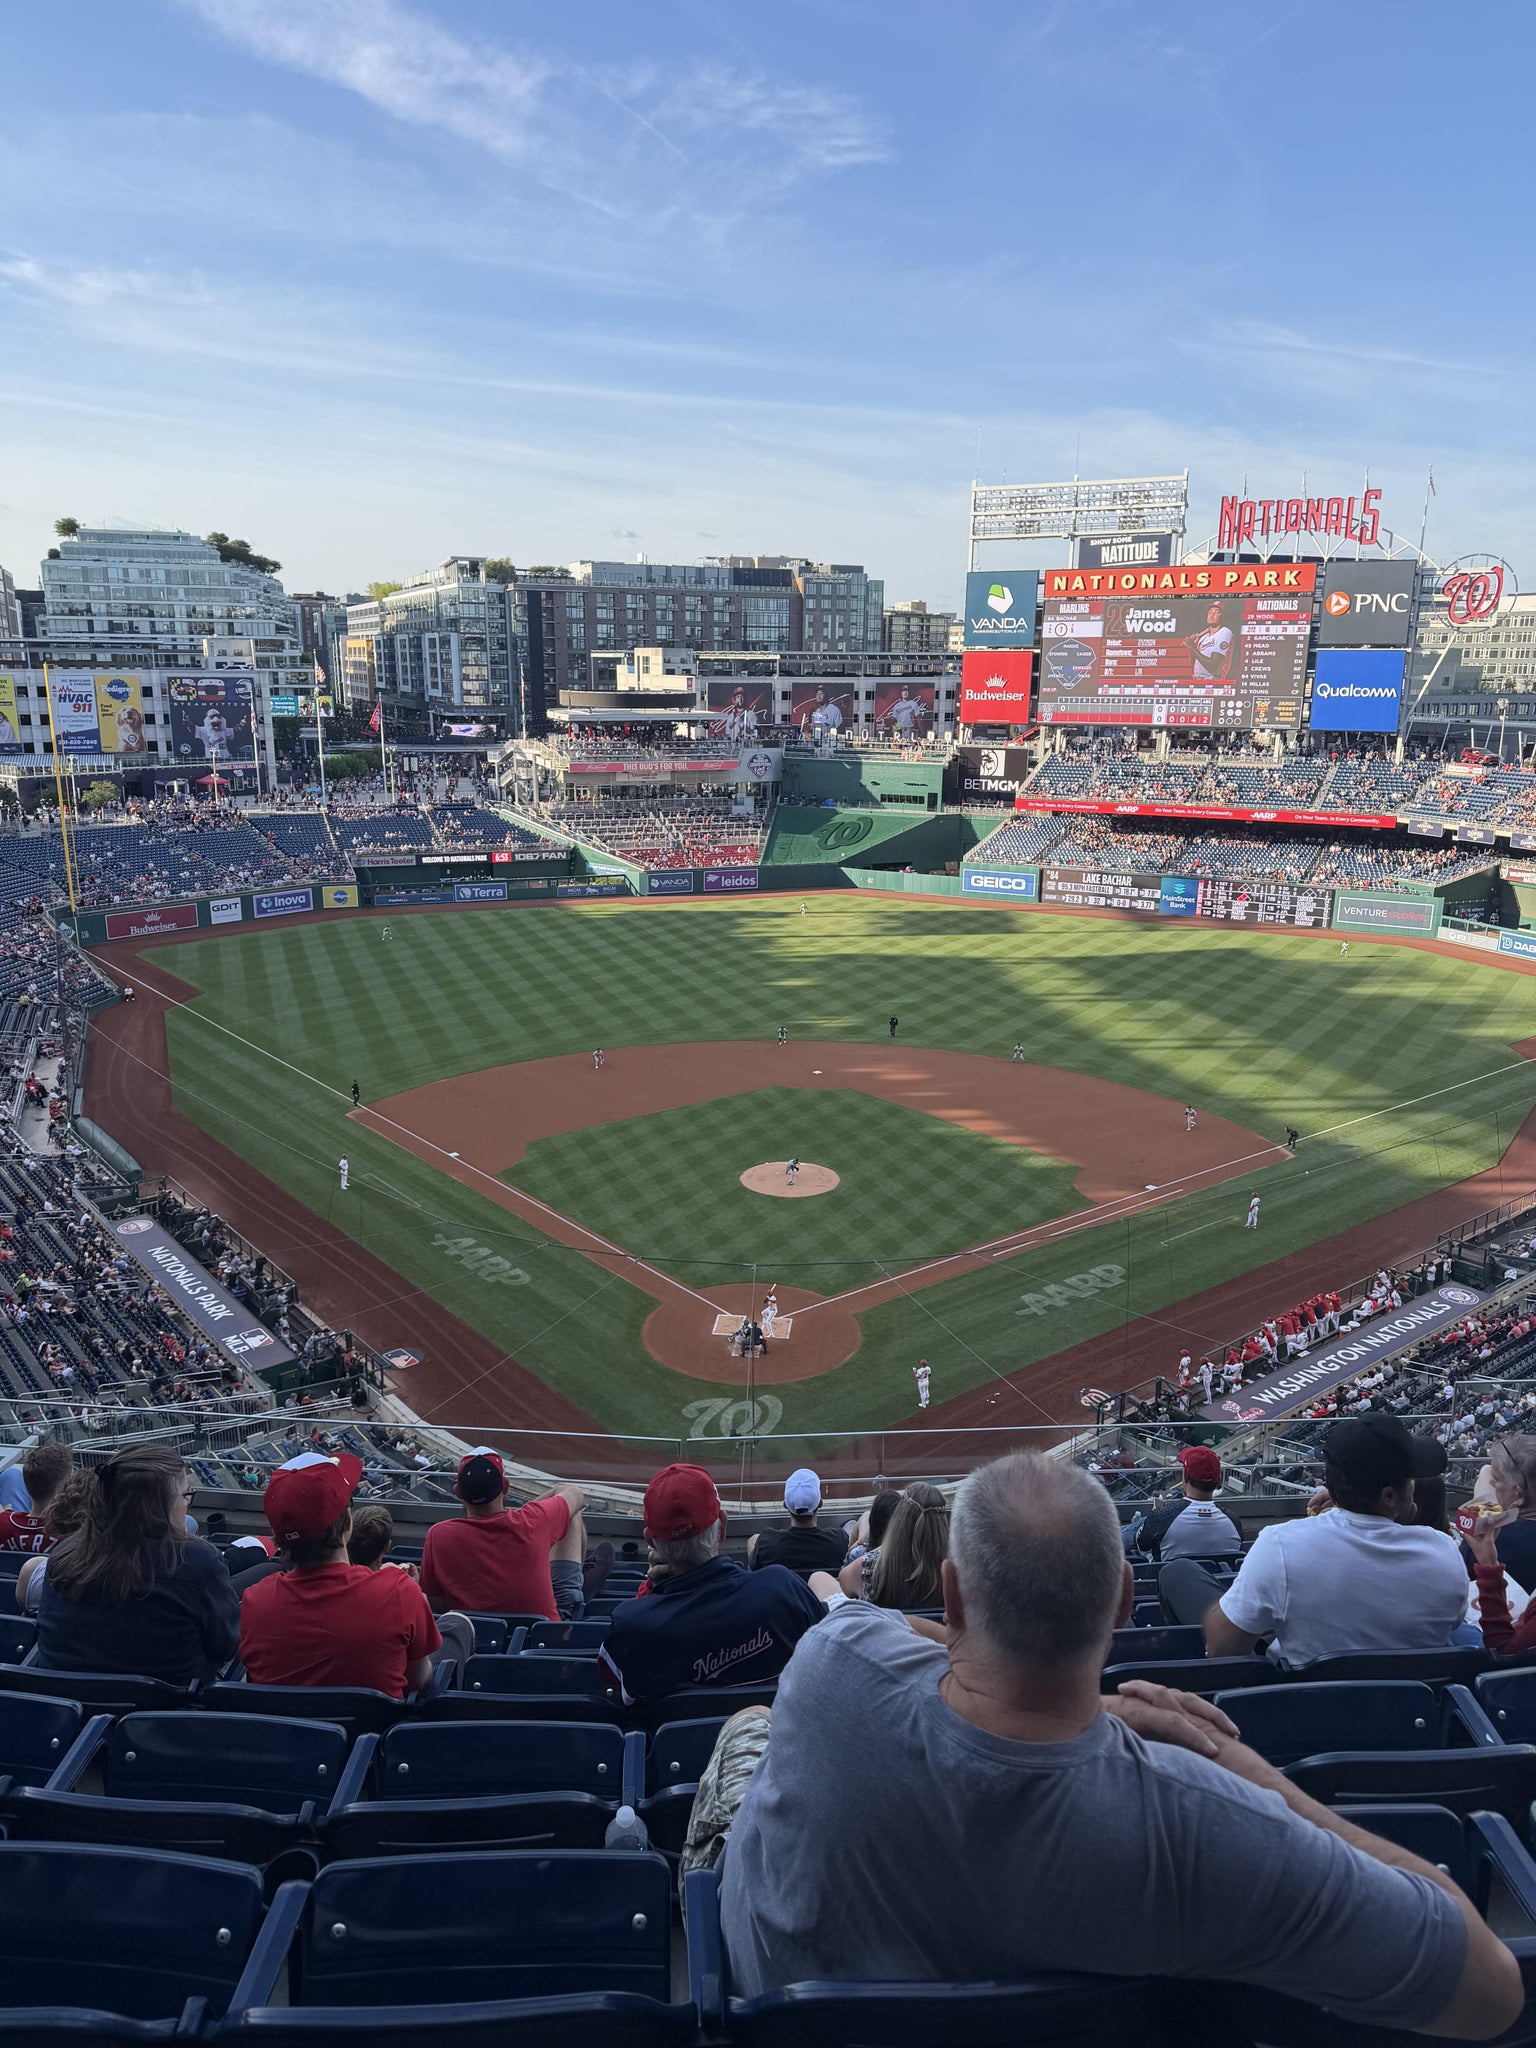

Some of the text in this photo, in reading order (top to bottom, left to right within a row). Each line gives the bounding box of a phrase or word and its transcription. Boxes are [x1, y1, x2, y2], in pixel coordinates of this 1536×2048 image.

[1218, 489, 1382, 549] NATIONALS
[1090, 536, 1132, 546] SHOW SOME
[1101, 541, 1159, 563] NATITUDE
[1054, 570, 1302, 590] NATIONALS PARK
[1443, 566, 1503, 624] W
[1060, 603, 1089, 613] MARLINS
[1257, 600, 1298, 611] NATIONALS
[1354, 593, 1409, 613] PNC
[1125, 608, 1171, 619] James
[971, 617, 1028, 629] VANDA
[1125, 618, 1176, 633] Wood
[100, 685, 135, 693] Pedigree
[965, 689, 1025, 701] Budweiser
[1317, 683, 1397, 698] Qualcomm
[58, 694, 93, 703] HVAC
[72, 703, 92, 713] 911
[964, 777, 1019, 792] BETMGM
[388, 857, 414, 865] Teeter
[495, 853, 508, 862] 6:53
[542, 852, 566, 860] FAN
[721, 874, 756, 887] leidos
[1046, 870, 1059, 880] #84
[1082, 873, 1132, 887] LAKE BACHAR
[970, 874, 1026, 890] GEICO
[472, 887, 503, 897] Terra
[1086, 885, 1110, 893] FASTBALL
[274, 894, 306, 907] Inova
[1141, 901, 1152, 909] 3.77
[1162, 894, 1195, 904] MainStreet
[1169, 901, 1186, 909] Bank
[212, 902, 240, 912] GDIT
[1343, 906, 1427, 922] VENTURE GLOBAL
[129, 922, 177, 935] Budweiser
[430, 1233, 532, 1285] AARP
[147, 1246, 234, 1321] NATIONALS PARK
[1015, 1264, 1127, 1316] AARP
[222, 1334, 250, 1354] MLB
[1251, 1300, 1451, 1405] WASHINGTON NATIONALS
[682, 1394, 783, 1443] W
[1459, 1515, 1473, 1530] W
[693, 1627, 773, 1682] Nationals
